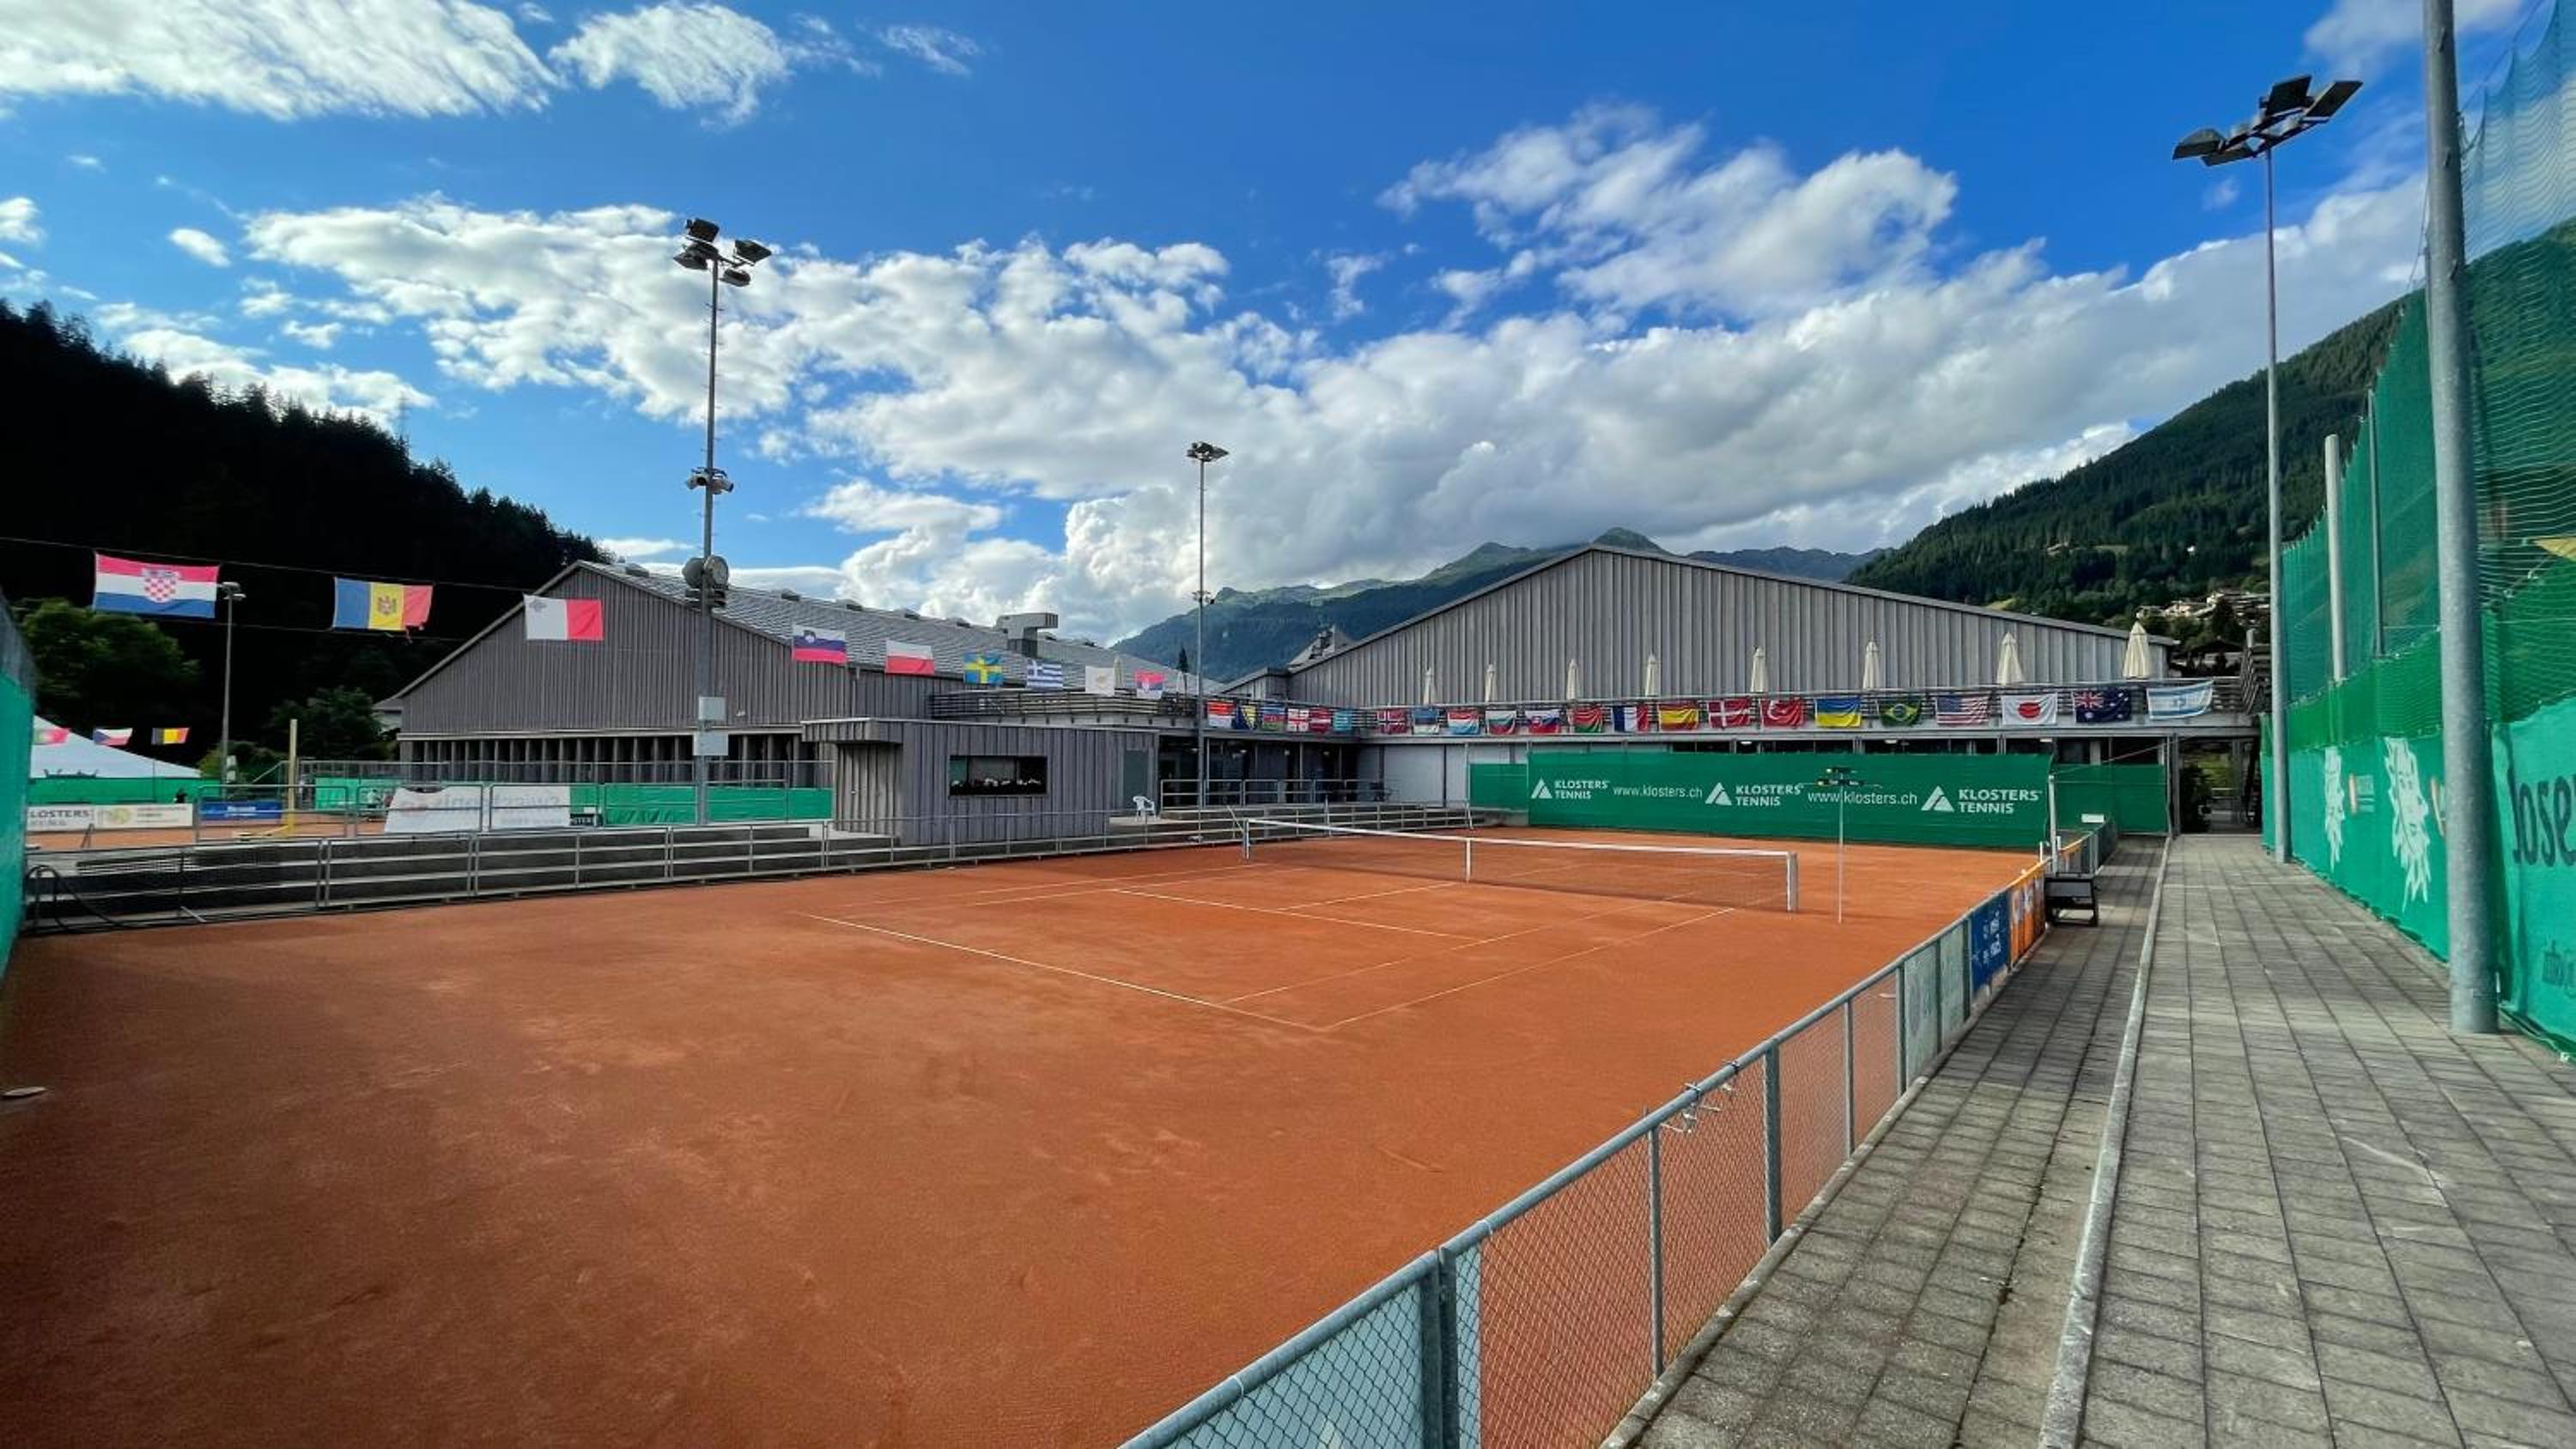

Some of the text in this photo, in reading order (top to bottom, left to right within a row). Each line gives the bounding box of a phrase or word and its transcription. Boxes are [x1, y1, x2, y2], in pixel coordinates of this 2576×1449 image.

[1554, 779, 1608, 790] KLOSTERS
[1735, 784, 1801, 796] KLOSTERS
[1554, 790, 1592, 800] TENNIS
[1613, 785, 1703, 798] www.klosters.ch
[1958, 788, 2040, 802] KLOSTERS
[1735, 795, 1782, 807] TENNIS
[1807, 791, 1917, 806] wwwklosters.ch
[1958, 802, 2014, 815] TENNIS
[2507, 766, 2576, 867] Jose
